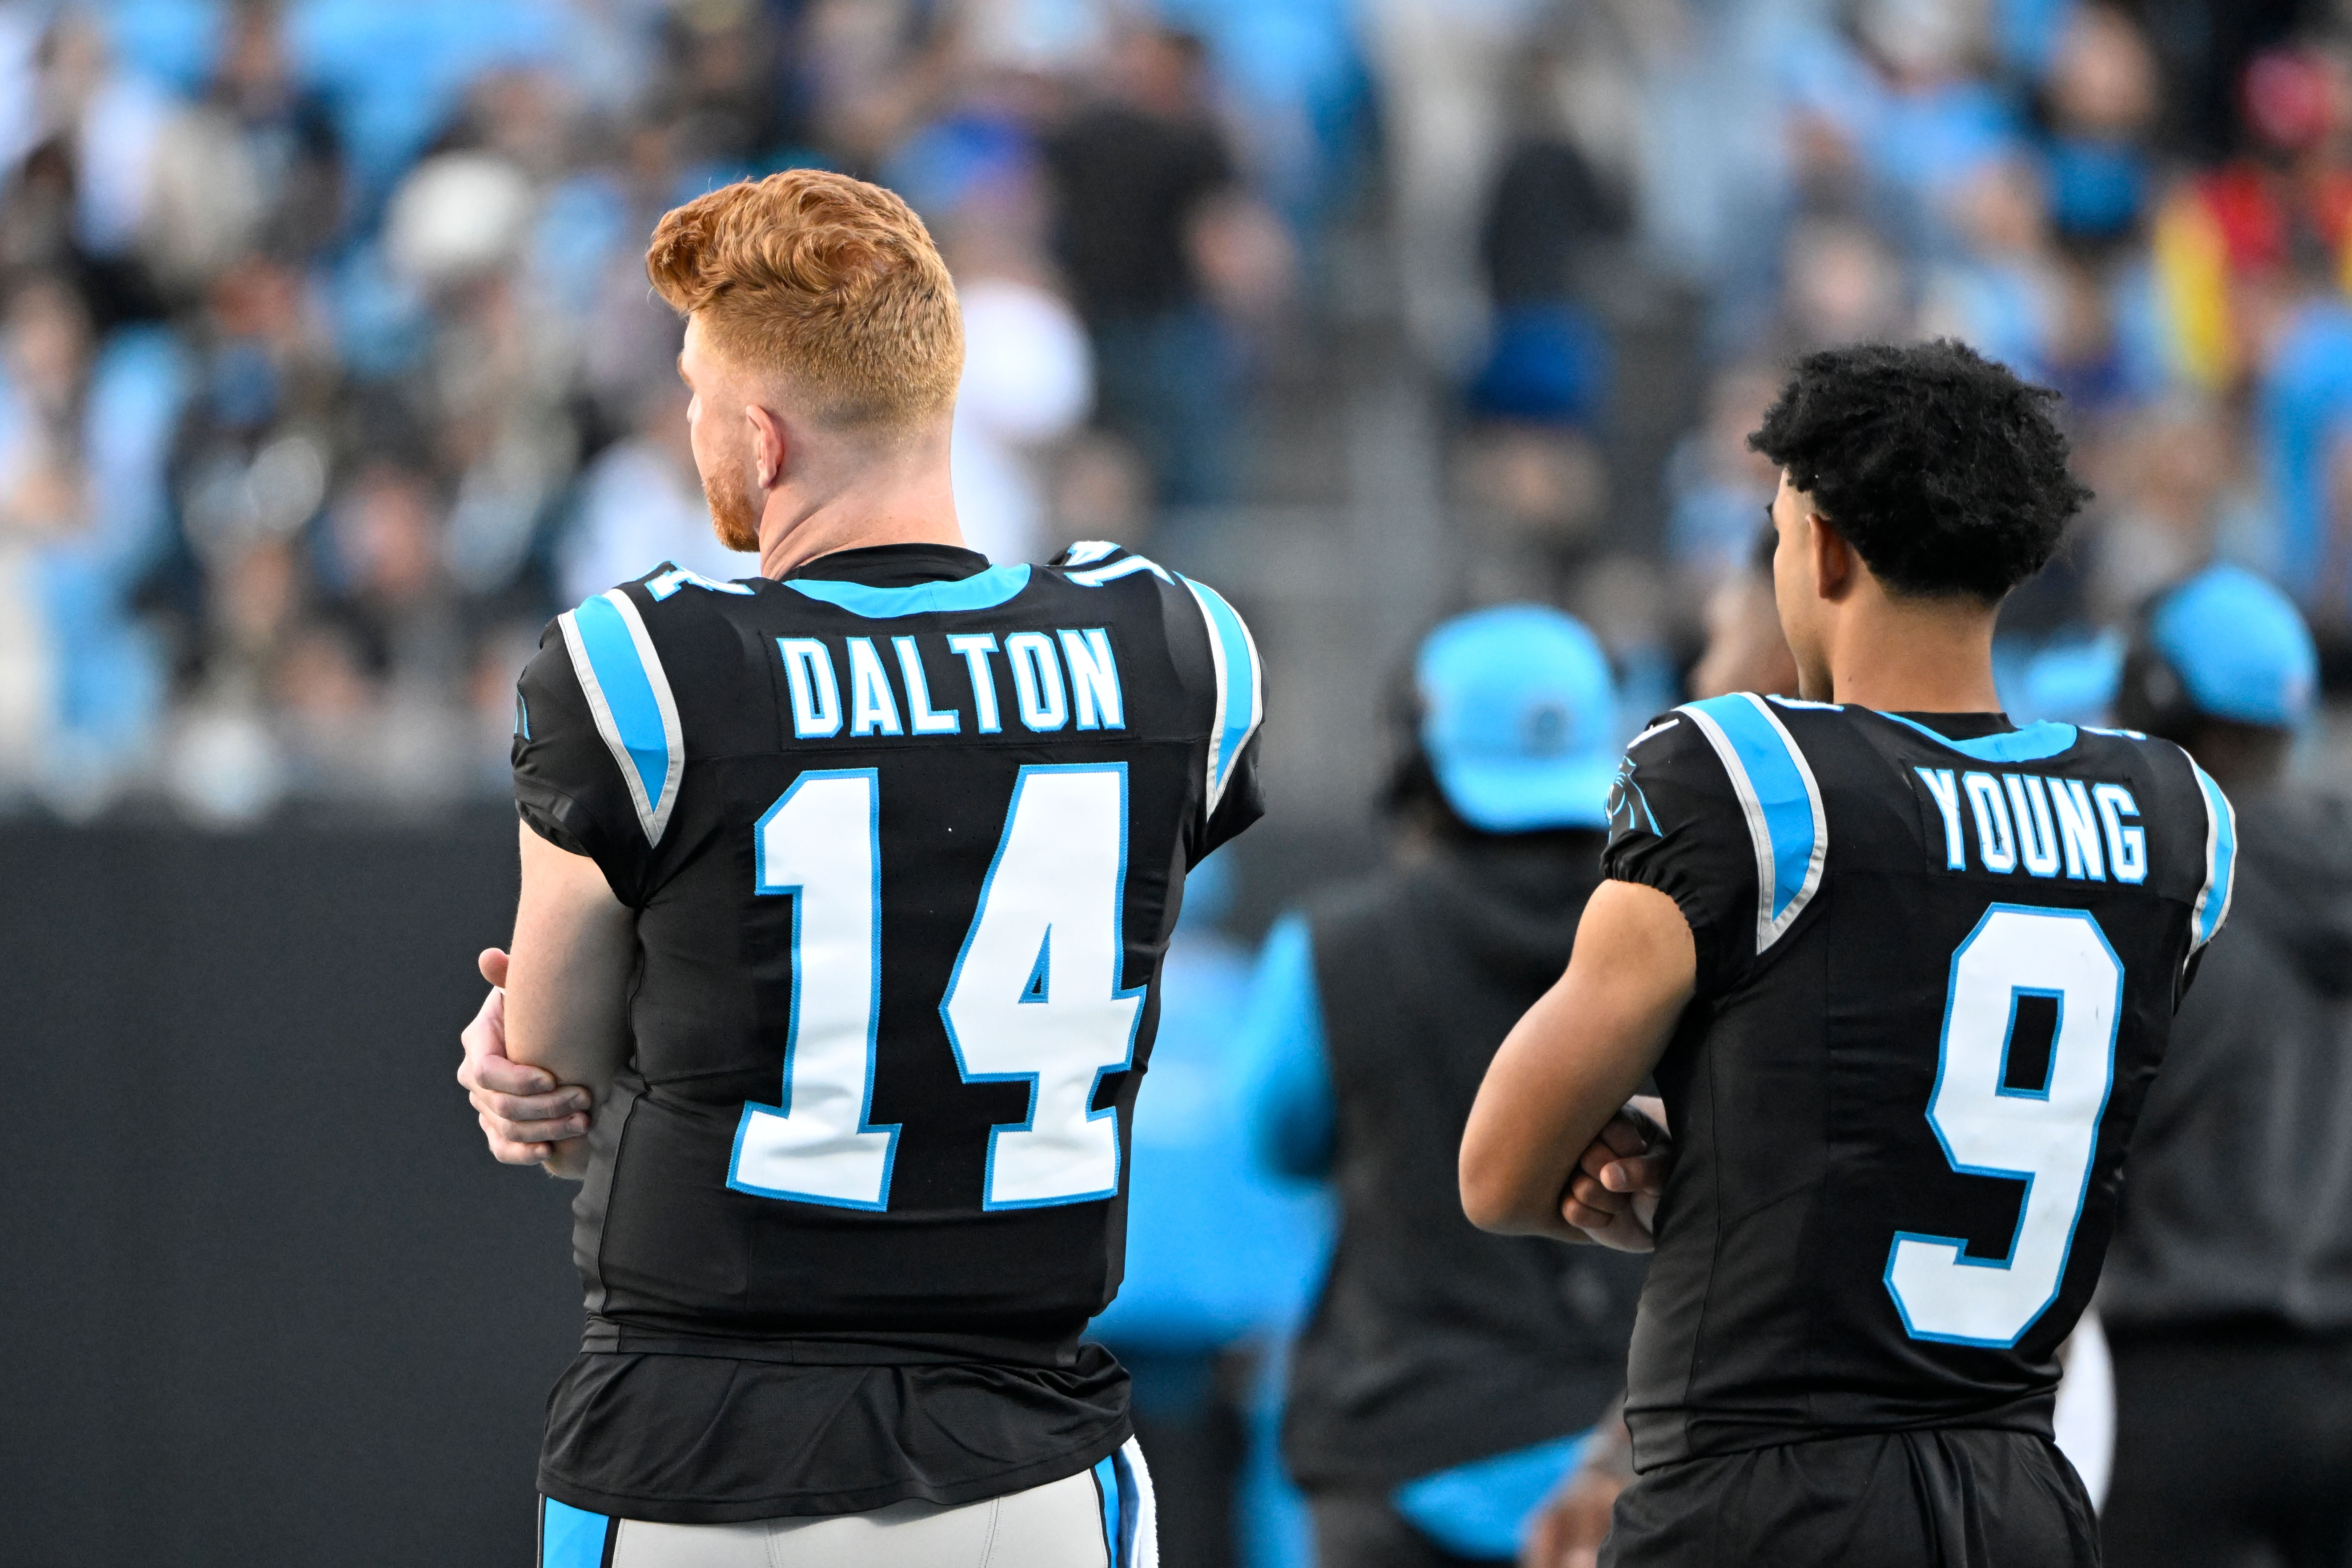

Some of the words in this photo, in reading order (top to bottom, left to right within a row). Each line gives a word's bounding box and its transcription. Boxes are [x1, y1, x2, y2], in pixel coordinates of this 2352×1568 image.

[775, 627, 1126, 740] DALTON
[1913, 766, 2148, 885] YOUNG
[726, 761, 1147, 1213] 14
[1882, 902, 2125, 1349] 9
